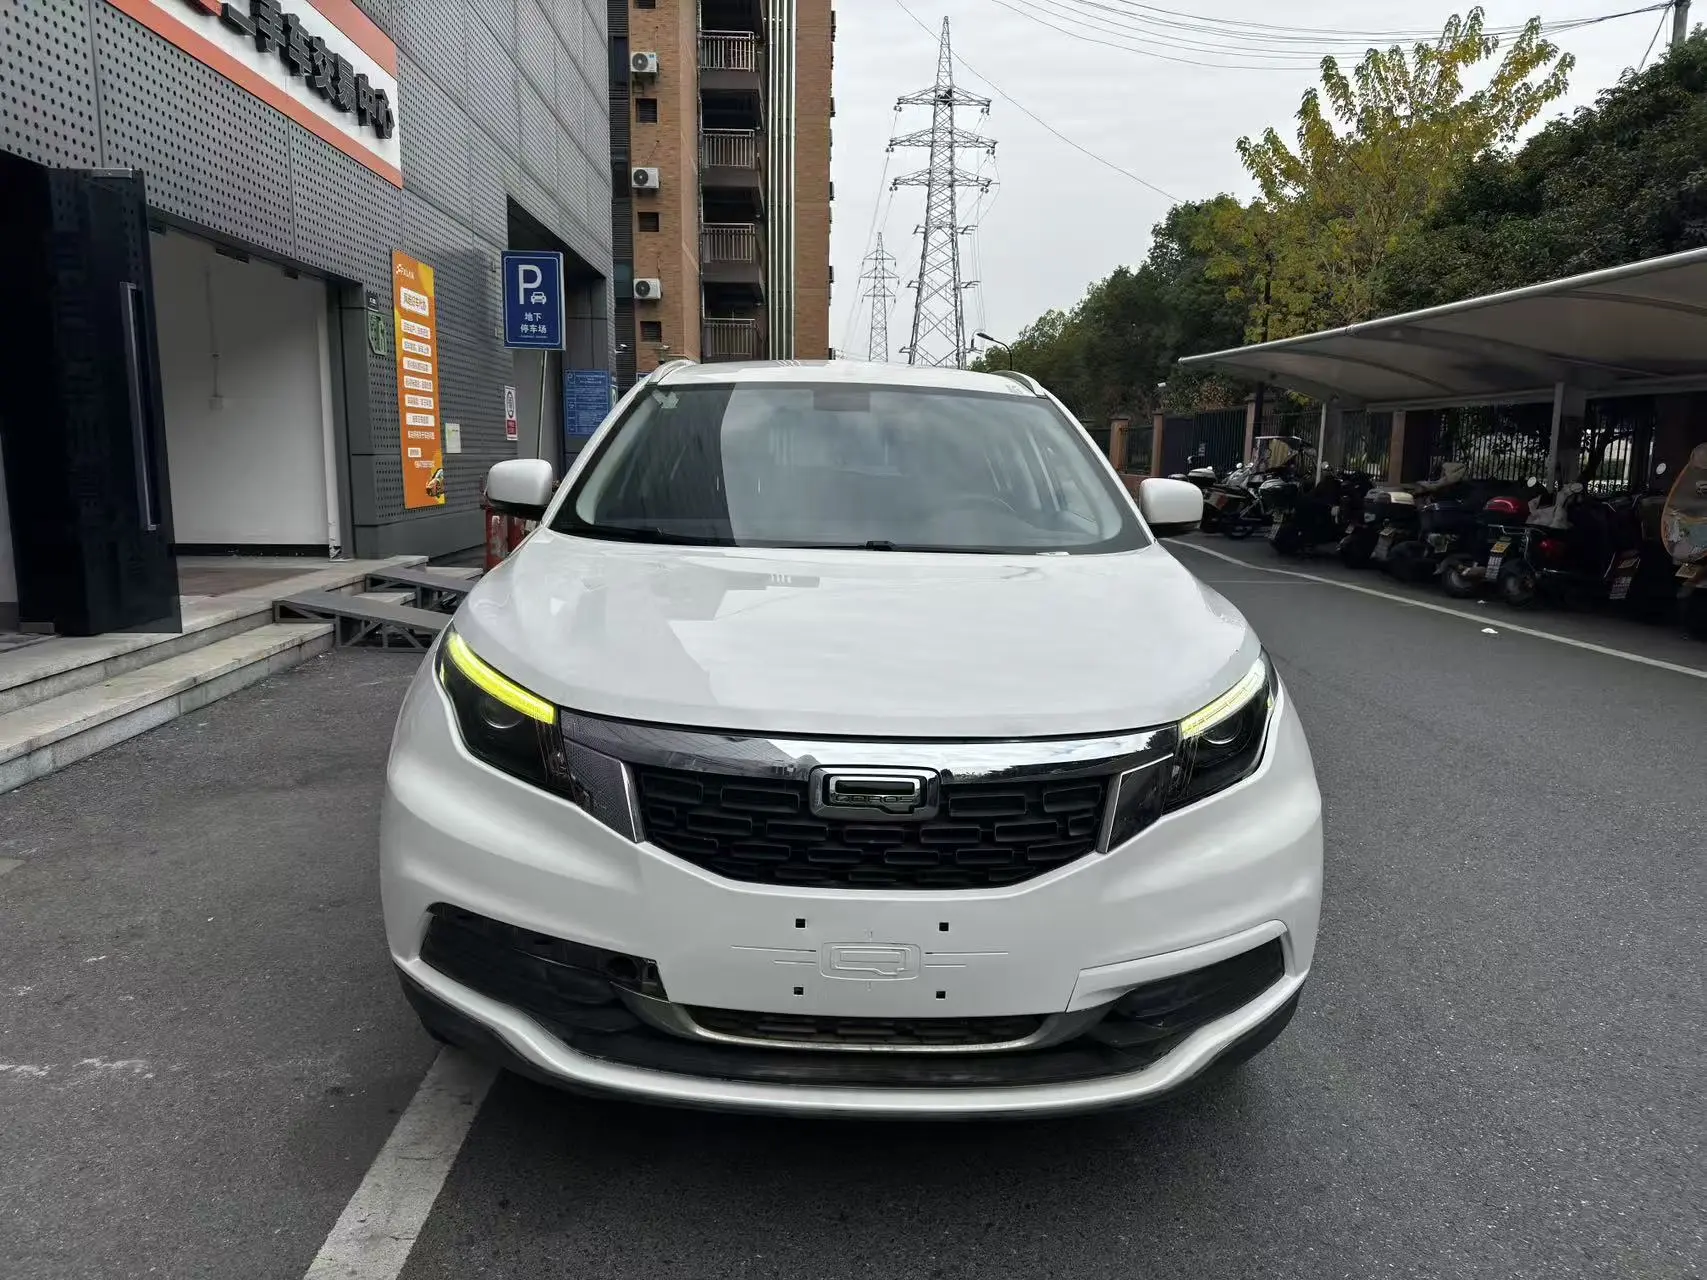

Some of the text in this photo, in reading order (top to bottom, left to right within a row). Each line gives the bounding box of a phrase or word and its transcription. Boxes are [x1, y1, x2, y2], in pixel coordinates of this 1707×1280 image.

[517, 264, 543, 305] P
[524, 311, 542, 322] 地下
[520, 323, 547, 334] 停车场
